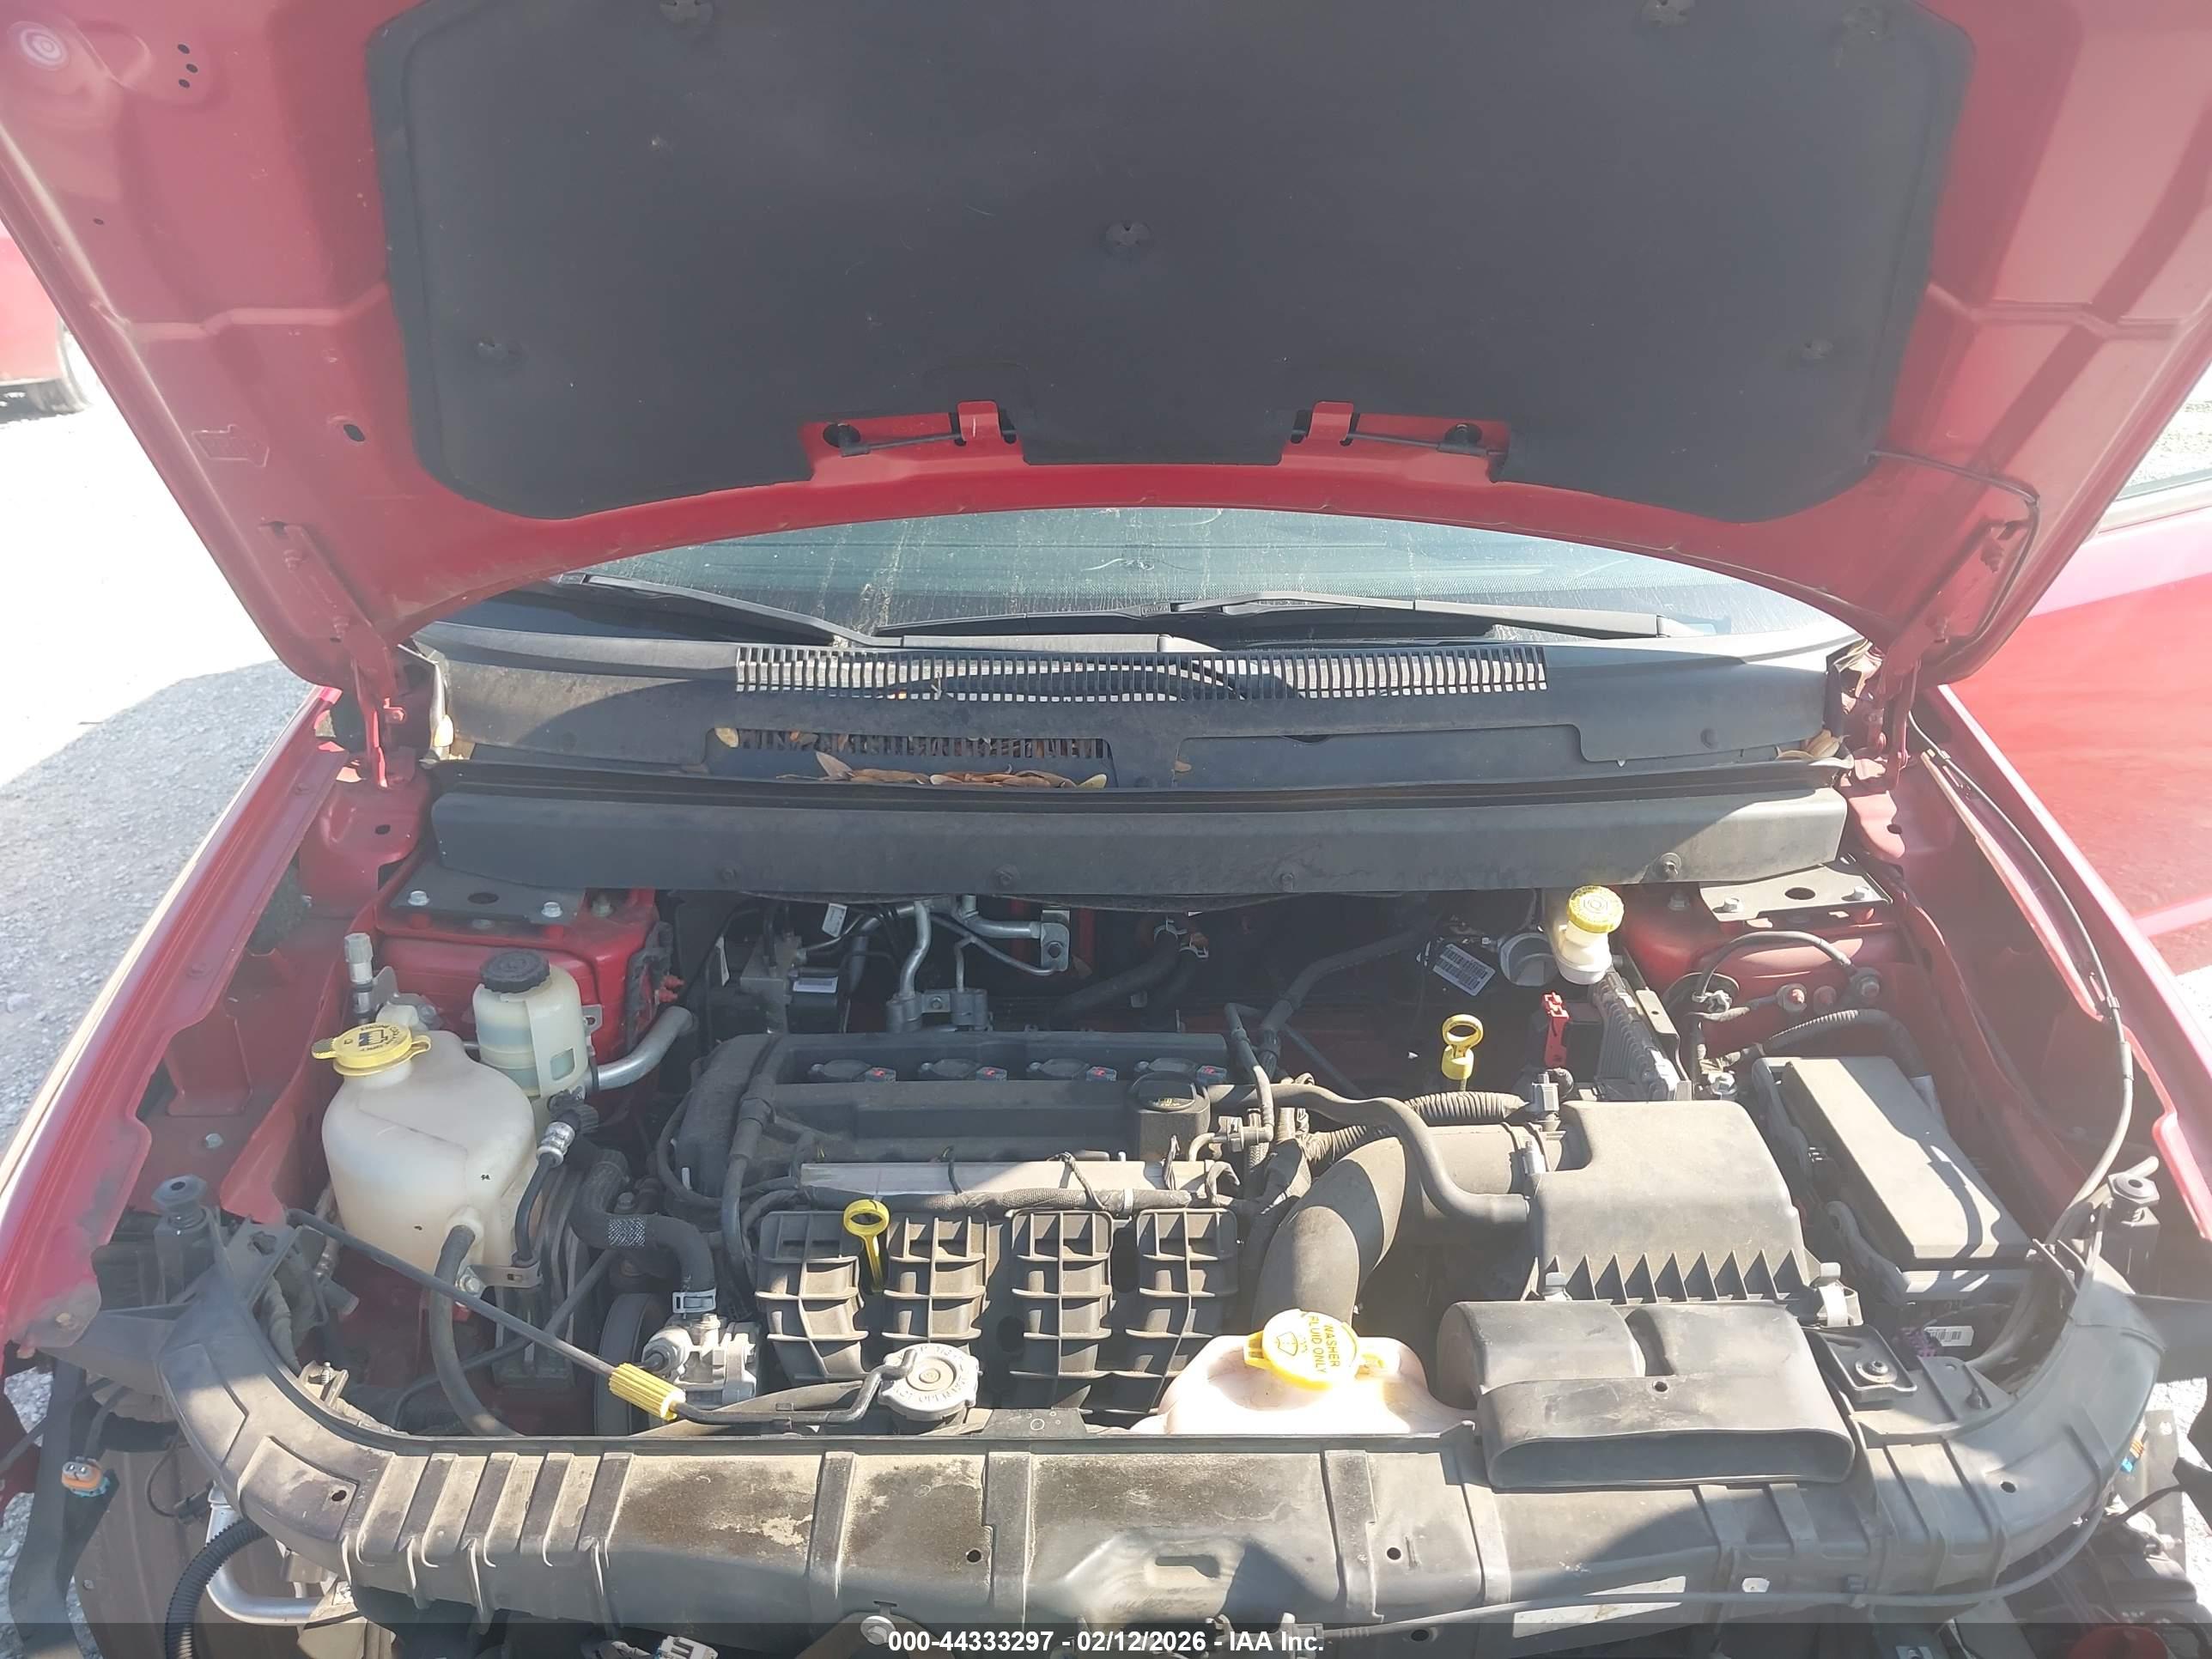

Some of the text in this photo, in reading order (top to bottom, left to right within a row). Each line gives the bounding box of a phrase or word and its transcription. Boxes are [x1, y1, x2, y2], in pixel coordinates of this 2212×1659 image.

[1309, 1315, 1327, 1373] FLUID ONLY
[1323, 1325, 1340, 1367] WASHER
